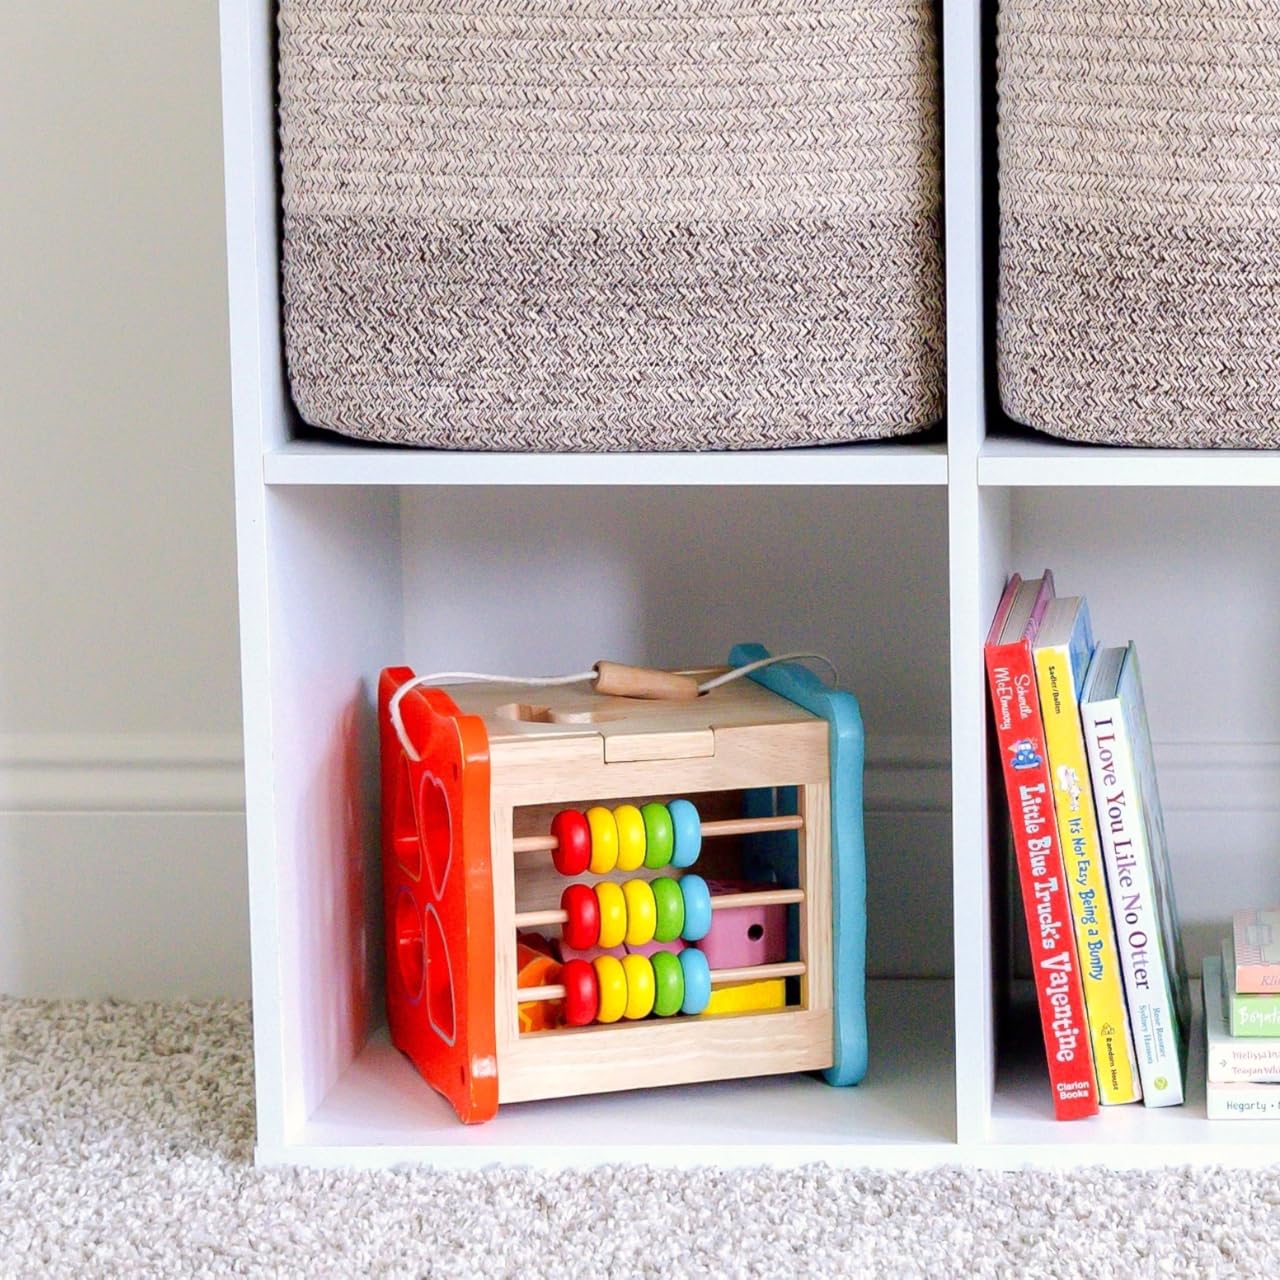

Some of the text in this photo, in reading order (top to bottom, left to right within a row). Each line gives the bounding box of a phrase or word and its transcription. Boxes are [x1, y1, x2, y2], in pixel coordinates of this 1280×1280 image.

[1068, 817, 1084, 834] It's
[1072, 837, 1086, 856] Not
[1094, 717, 1150, 990] I Love You Like No Otter
[1076, 860, 1091, 886] Easy
[1079, 888, 1098, 925] Being
[1019, 783, 1080, 1063] Little Blue Truck's Valentine
[1088, 940, 1104, 981] Bunny
[1106, 1037, 1119, 1090] Random House
[1056, 1081, 1090, 1091] Clarion
[1060, 1090, 1090, 1100] Books
[1226, 1101, 1267, 1113] Hegarty
